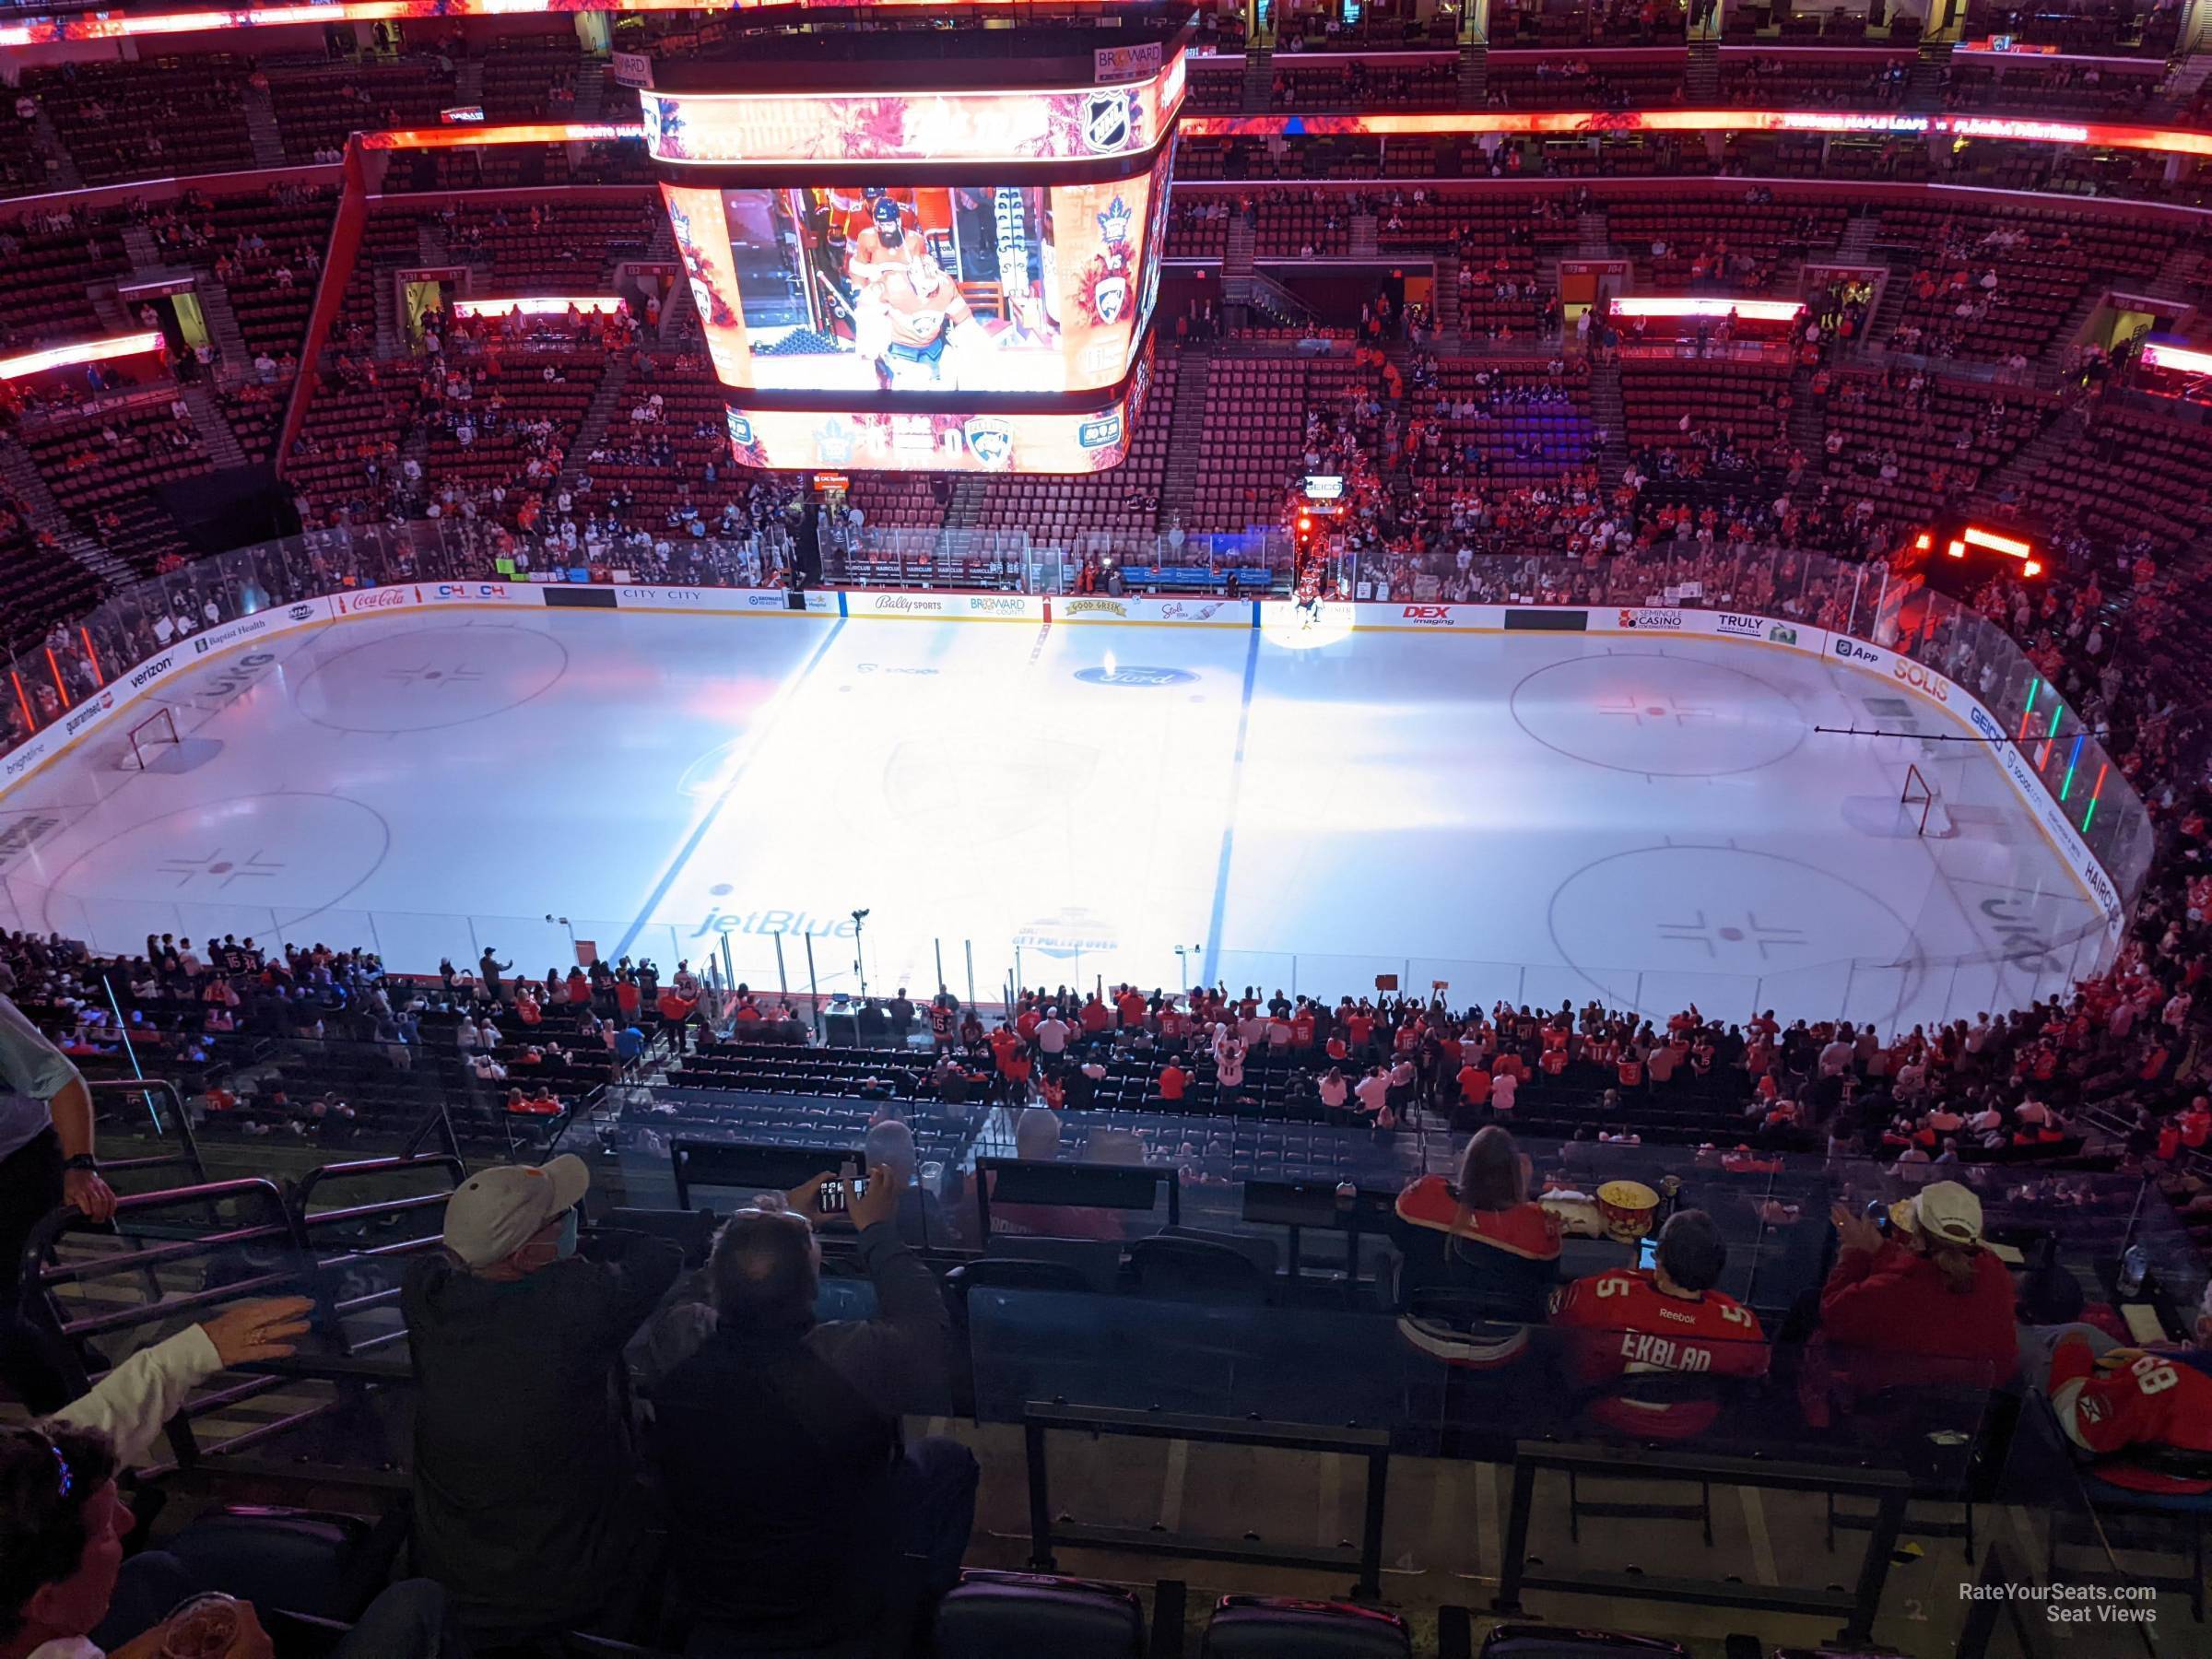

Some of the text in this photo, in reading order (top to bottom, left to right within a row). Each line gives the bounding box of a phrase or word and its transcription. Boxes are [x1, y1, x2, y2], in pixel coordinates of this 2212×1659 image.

[1094, 104, 1124, 142] NHL
[1845, 117, 1888, 129] MAPLE
[1890, 118, 1928, 130] LEAFS
[1953, 121, 2012, 135] FLORIDA
[2015, 124, 2088, 140] PANTHERS
[1305, 483, 1343, 491] GEICO
[439, 585, 465, 595] CH
[479, 585, 505, 595] CH
[623, 589, 656, 598] CITY
[668, 590, 701, 599] CITY
[875, 594, 913, 612] Bally
[913, 601, 942, 610] SPORTS
[971, 597, 1025, 610] BROWARD
[1072, 600, 1121, 613] GOOD GREEK
[288, 605, 312, 617] NHL
[1403, 606, 1452, 618] DEX
[1413, 618, 1454, 626] imaging
[1639, 617, 1682, 626] CASINO
[1719, 615, 1763, 629] TRULY
[209, 620, 265, 646] Baptist Health
[131, 656, 171, 688] verizon
[1893, 658, 1950, 702] SOLIS
[1971, 706, 2003, 753] GEICO
[690, 906, 856, 939] jetBlue
[933, 1017, 945, 1031] 16
[1224, 1066, 1234, 1077] 11
[1596, 1277, 1630, 1298] 5
[1659, 1307, 1697, 1324] Reebok
[1620, 1328, 1712, 1372] EKBLAD
[1904, 1599, 1928, 1621] 2
